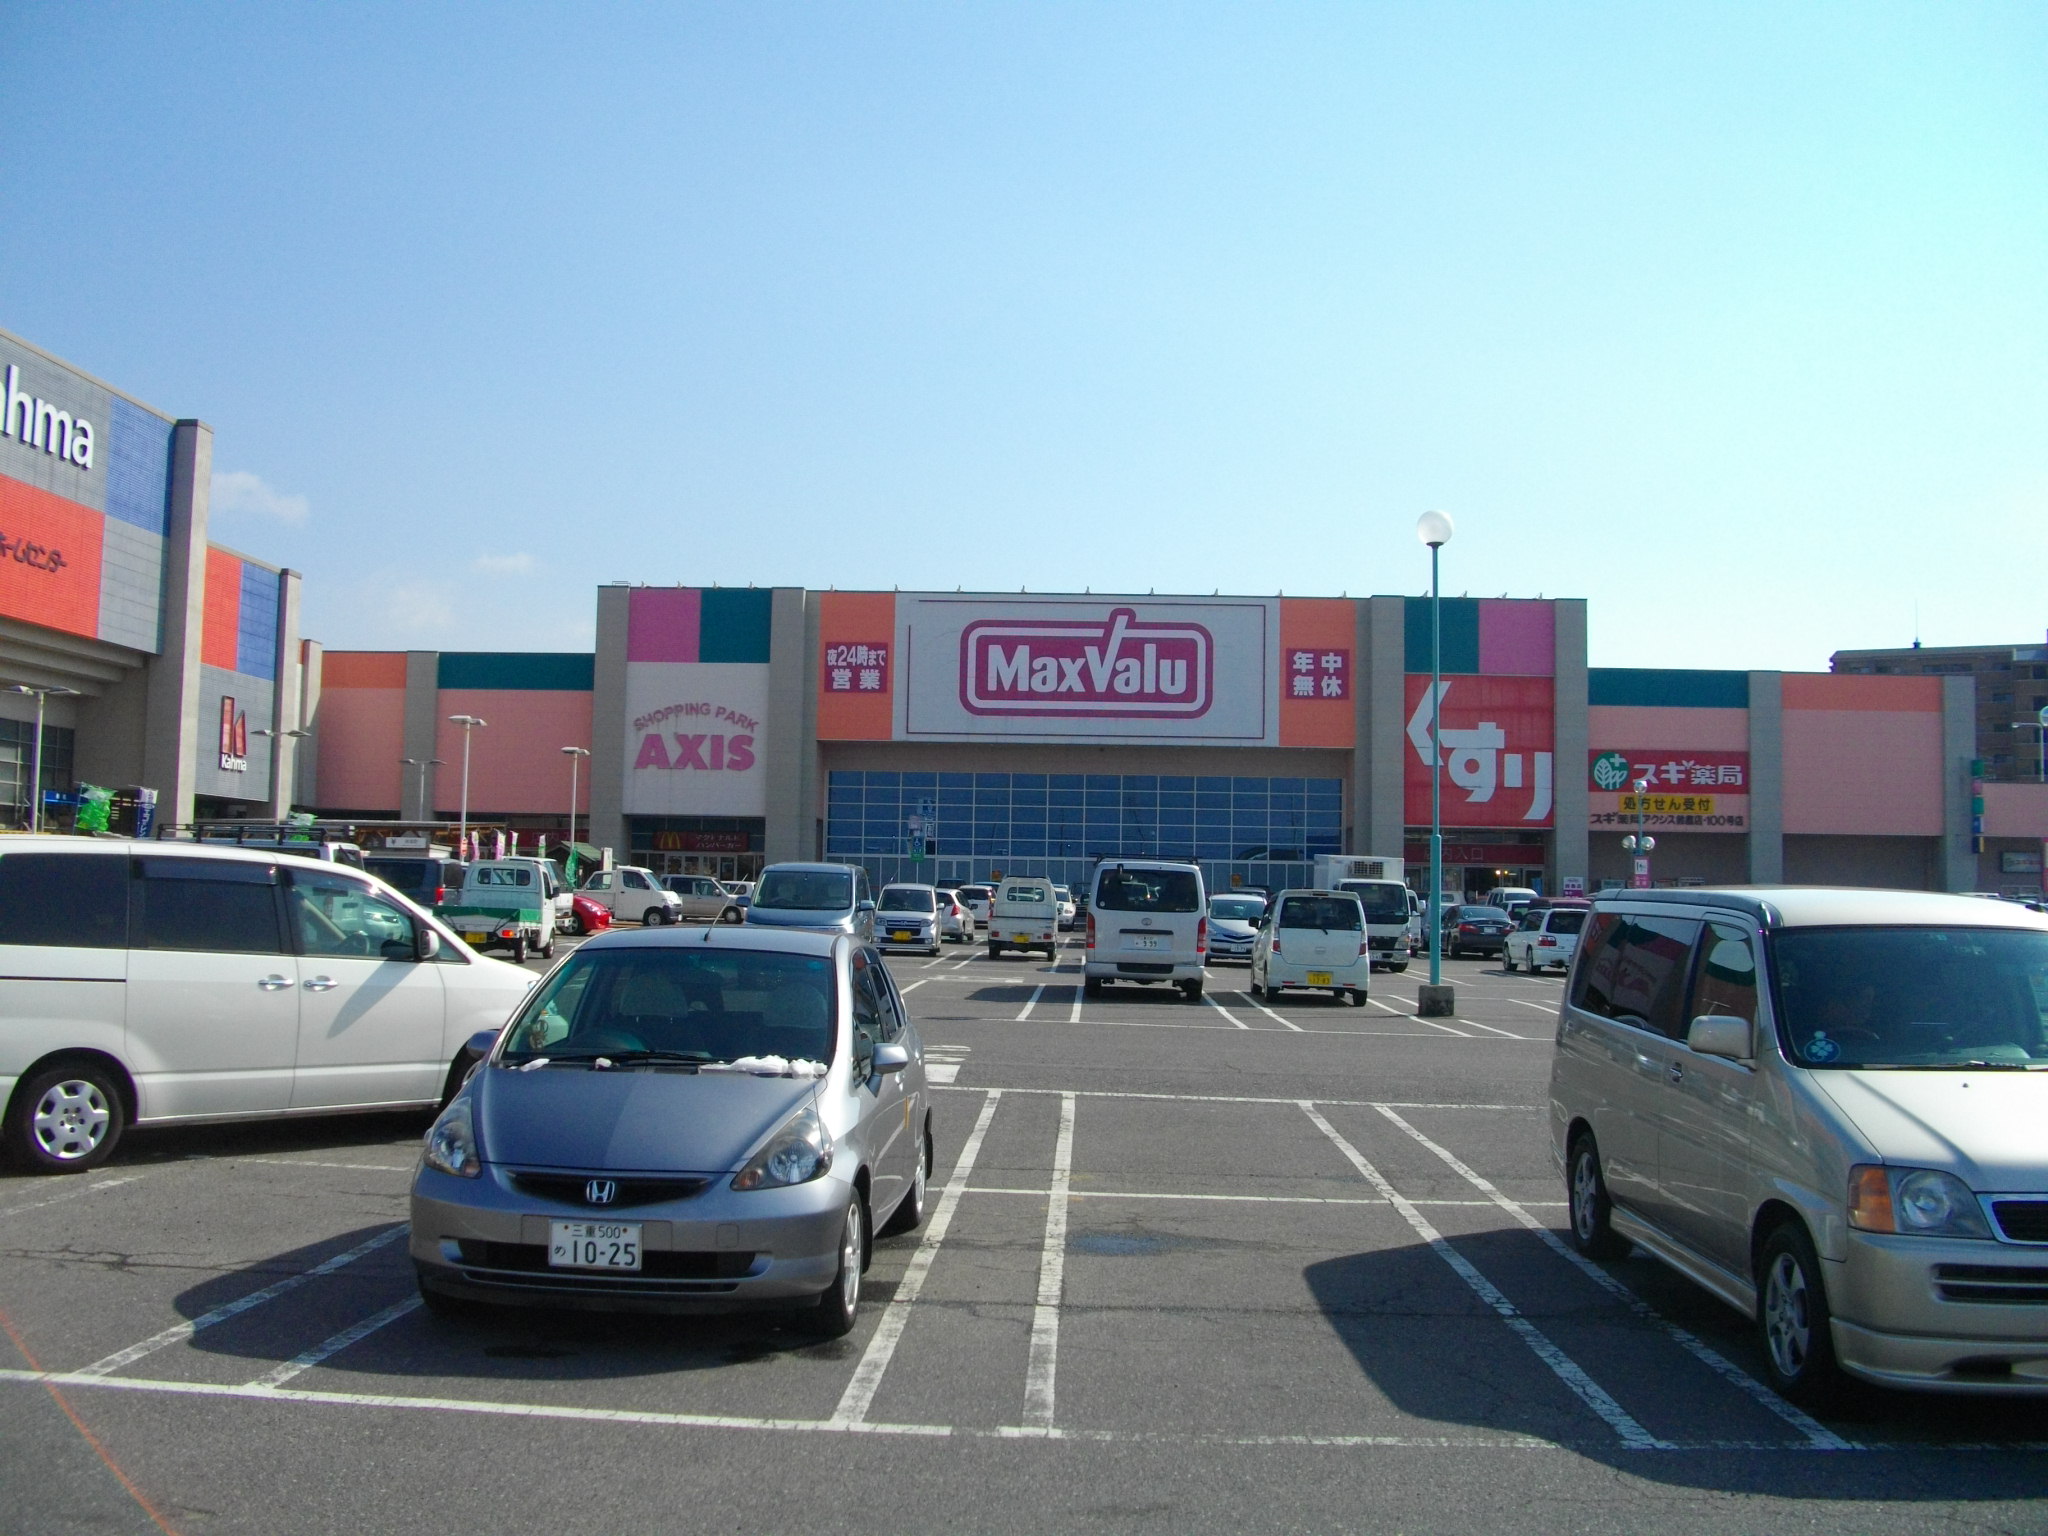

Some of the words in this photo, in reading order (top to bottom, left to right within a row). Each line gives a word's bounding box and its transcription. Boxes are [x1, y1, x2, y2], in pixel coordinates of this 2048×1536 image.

[0, 364, 95, 469] hma
[827, 645, 886, 667] 夜24時まで
[987, 614, 1187, 695] MaxValu
[1293, 651, 1342, 673] 年中
[832, 668, 880, 690] 営業
[1292, 675, 1342, 696] 無休
[633, 702, 711, 732] SHOPPING
[715, 706, 759, 733] PARK
[221, 752, 247, 771] Kahma
[633, 732, 755, 771] AXIS
[1405, 680, 1553, 820] くすり
[1632, 759, 1743, 786] スギ薬局
